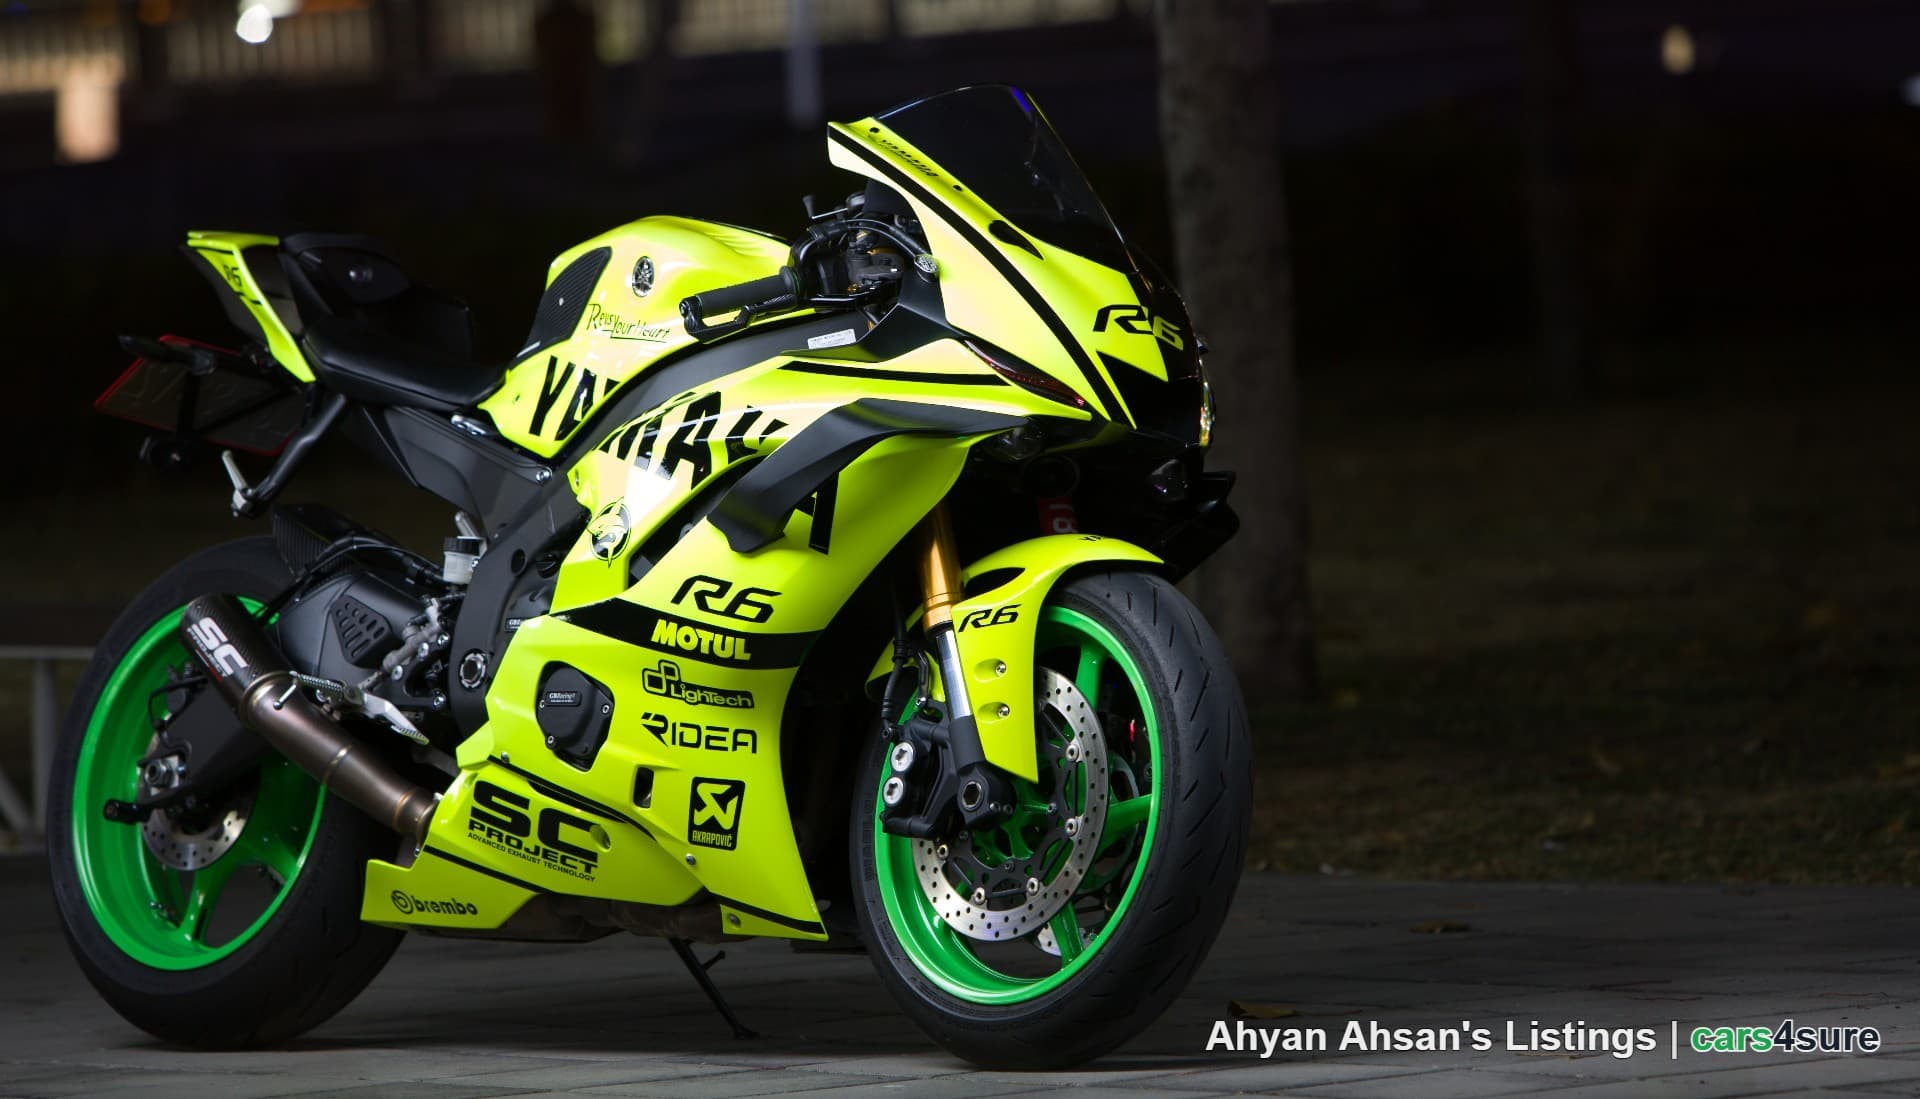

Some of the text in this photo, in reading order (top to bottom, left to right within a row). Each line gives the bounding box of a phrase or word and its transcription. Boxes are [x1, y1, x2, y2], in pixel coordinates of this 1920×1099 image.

[1093, 304, 1184, 351] R6
[670, 574, 783, 624] R6
[958, 604, 1022, 632] R6
[191, 616, 249, 677] SC
[651, 618, 752, 661] MOTUL
[641, 712, 758, 755] RIDEA
[470, 780, 599, 864] SC
[467, 831, 597, 883] ADVANCED EXHAUST TECHNOLOGY
[468, 818, 598, 875] PROJECT
[411, 895, 478, 916] brembo
